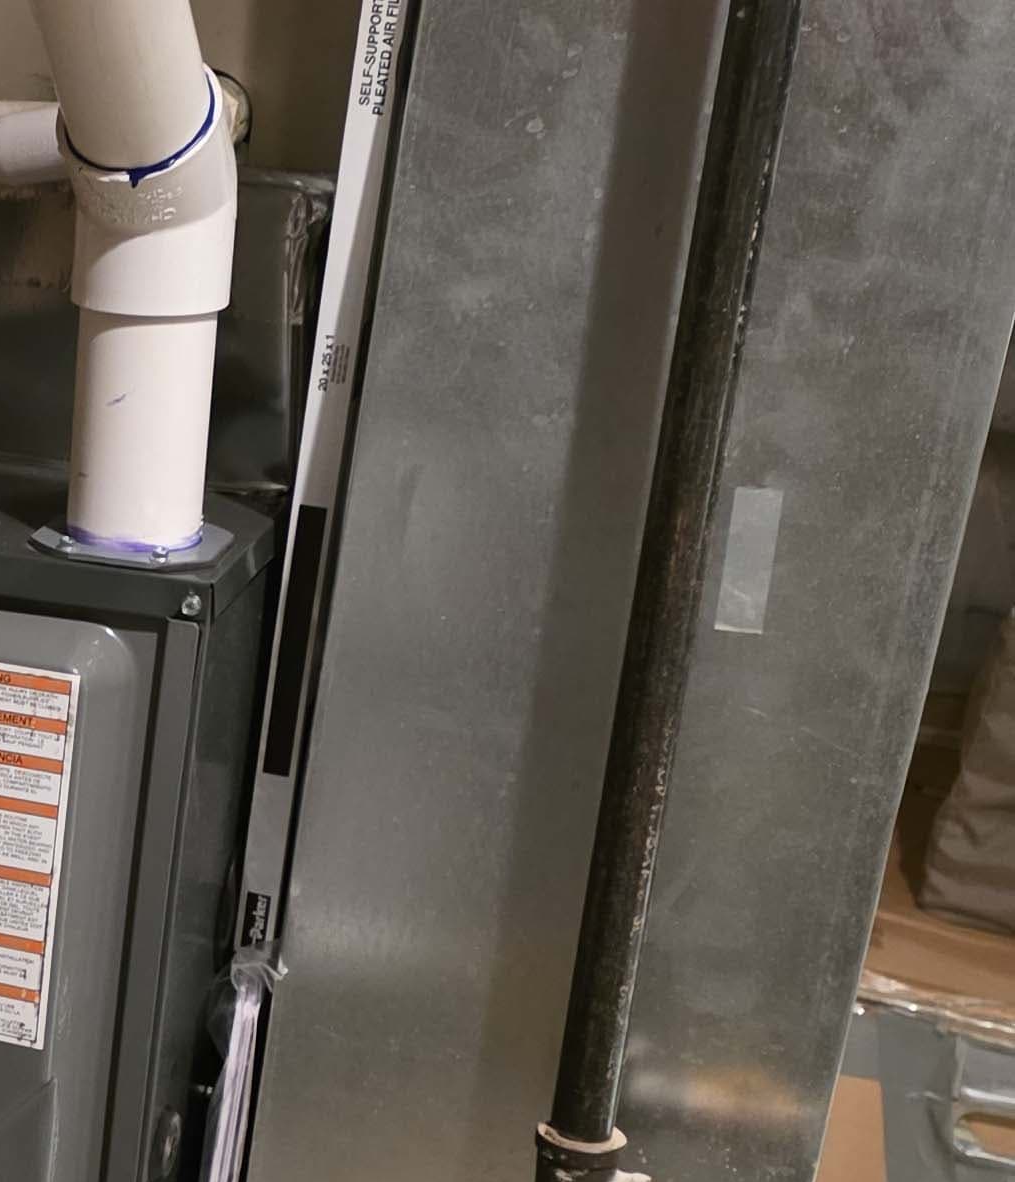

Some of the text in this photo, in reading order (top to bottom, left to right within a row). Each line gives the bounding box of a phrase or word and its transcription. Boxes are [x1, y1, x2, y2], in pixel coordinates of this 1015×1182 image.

[382, 22, 396, 47] AIR
[372, 50, 393, 115] PLEATED
[321, 353, 332, 366] 25
[318, 378, 328, 392] 20
[249, 895, 267, 944] Parker
